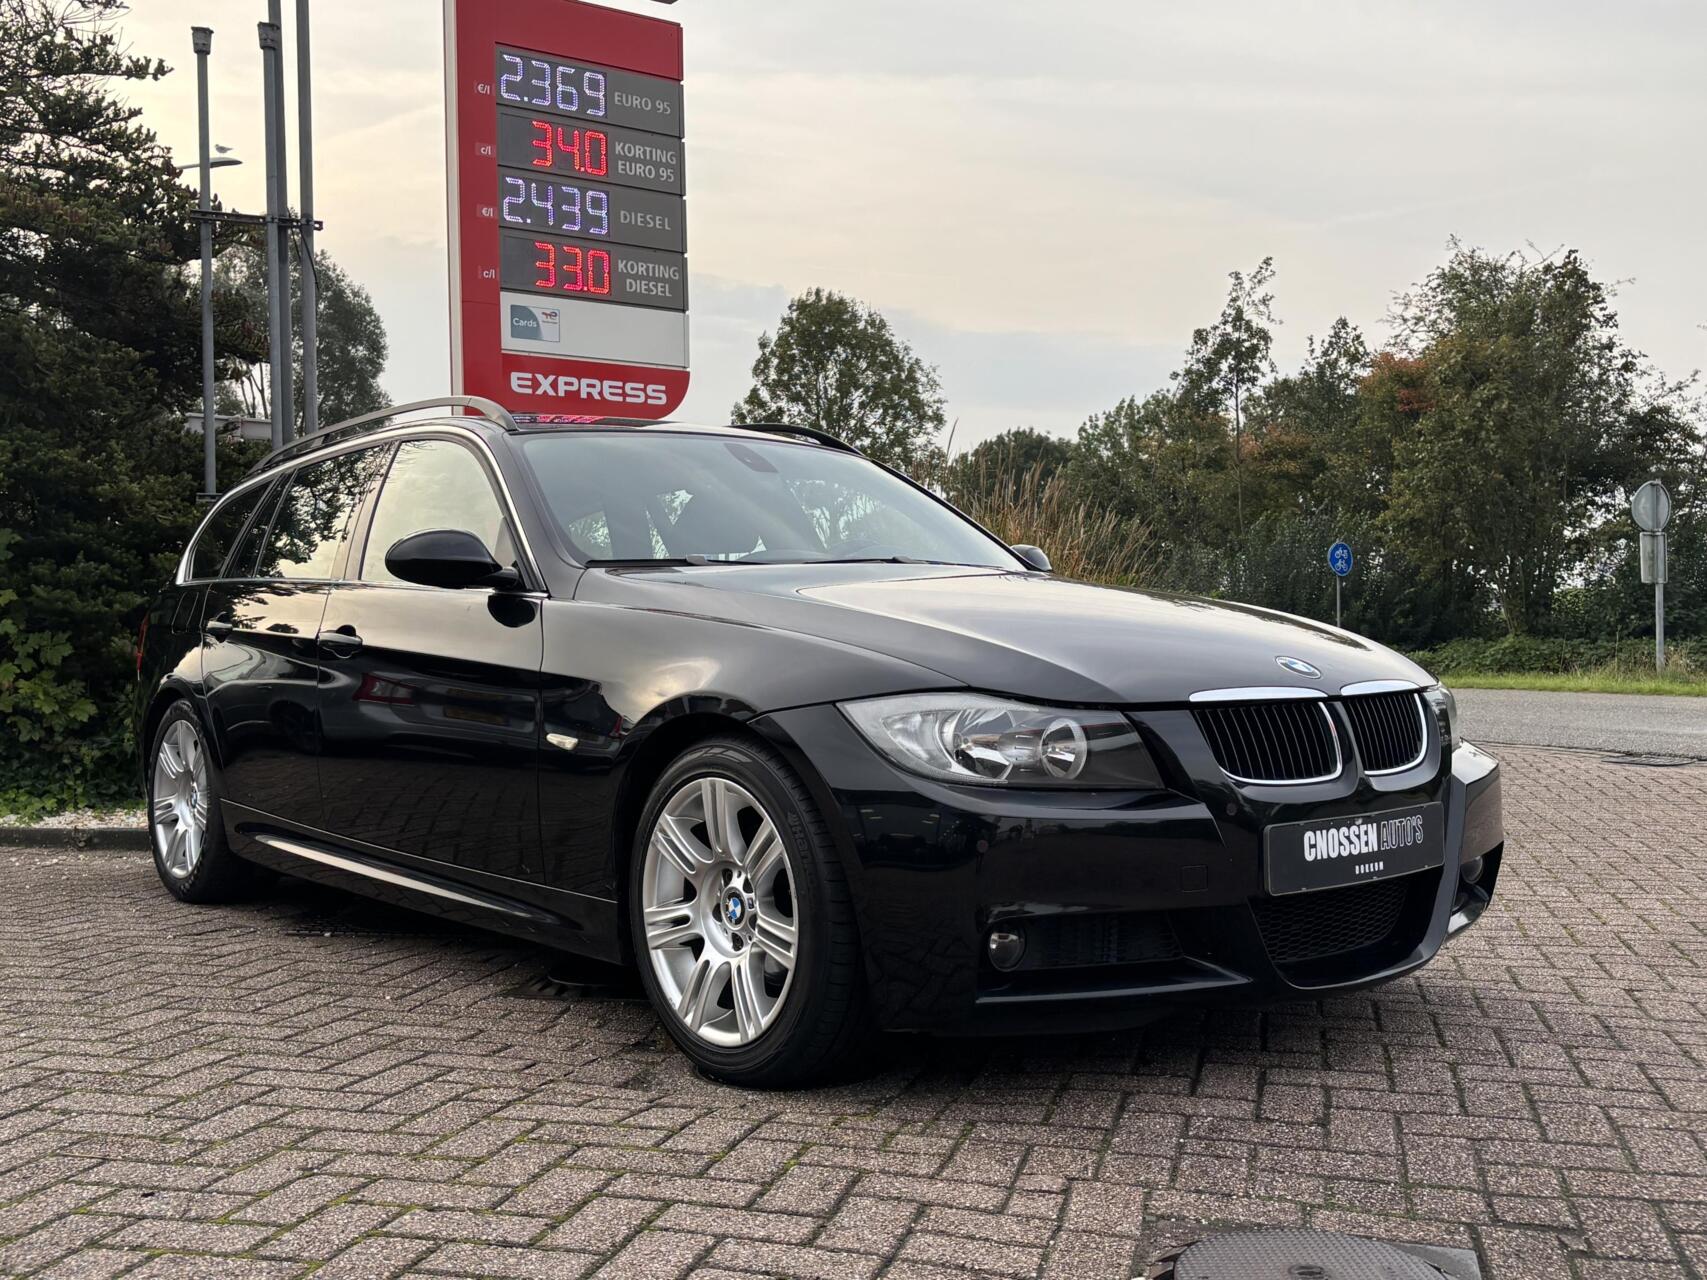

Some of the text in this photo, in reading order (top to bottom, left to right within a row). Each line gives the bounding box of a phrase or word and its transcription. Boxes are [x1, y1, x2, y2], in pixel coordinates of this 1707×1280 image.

[501, 54, 606, 117] 2.369
[614, 91, 671, 115] EURO 95
[532, 120, 608, 176] 34.0
[615, 141, 677, 165] KORTING
[617, 160, 675, 182] EURO 95
[503, 176, 609, 235] 2.439
[620, 210, 672, 230] DIESEL
[535, 242, 610, 295] 33.0
[618, 259, 680, 280] KORTING
[626, 278, 673, 297] DIESEL
[512, 317, 537, 329] Cards
[510, 371, 667, 405] EXPRESS
[1303, 814, 1424, 862] CNOSSEN AUTO'S
